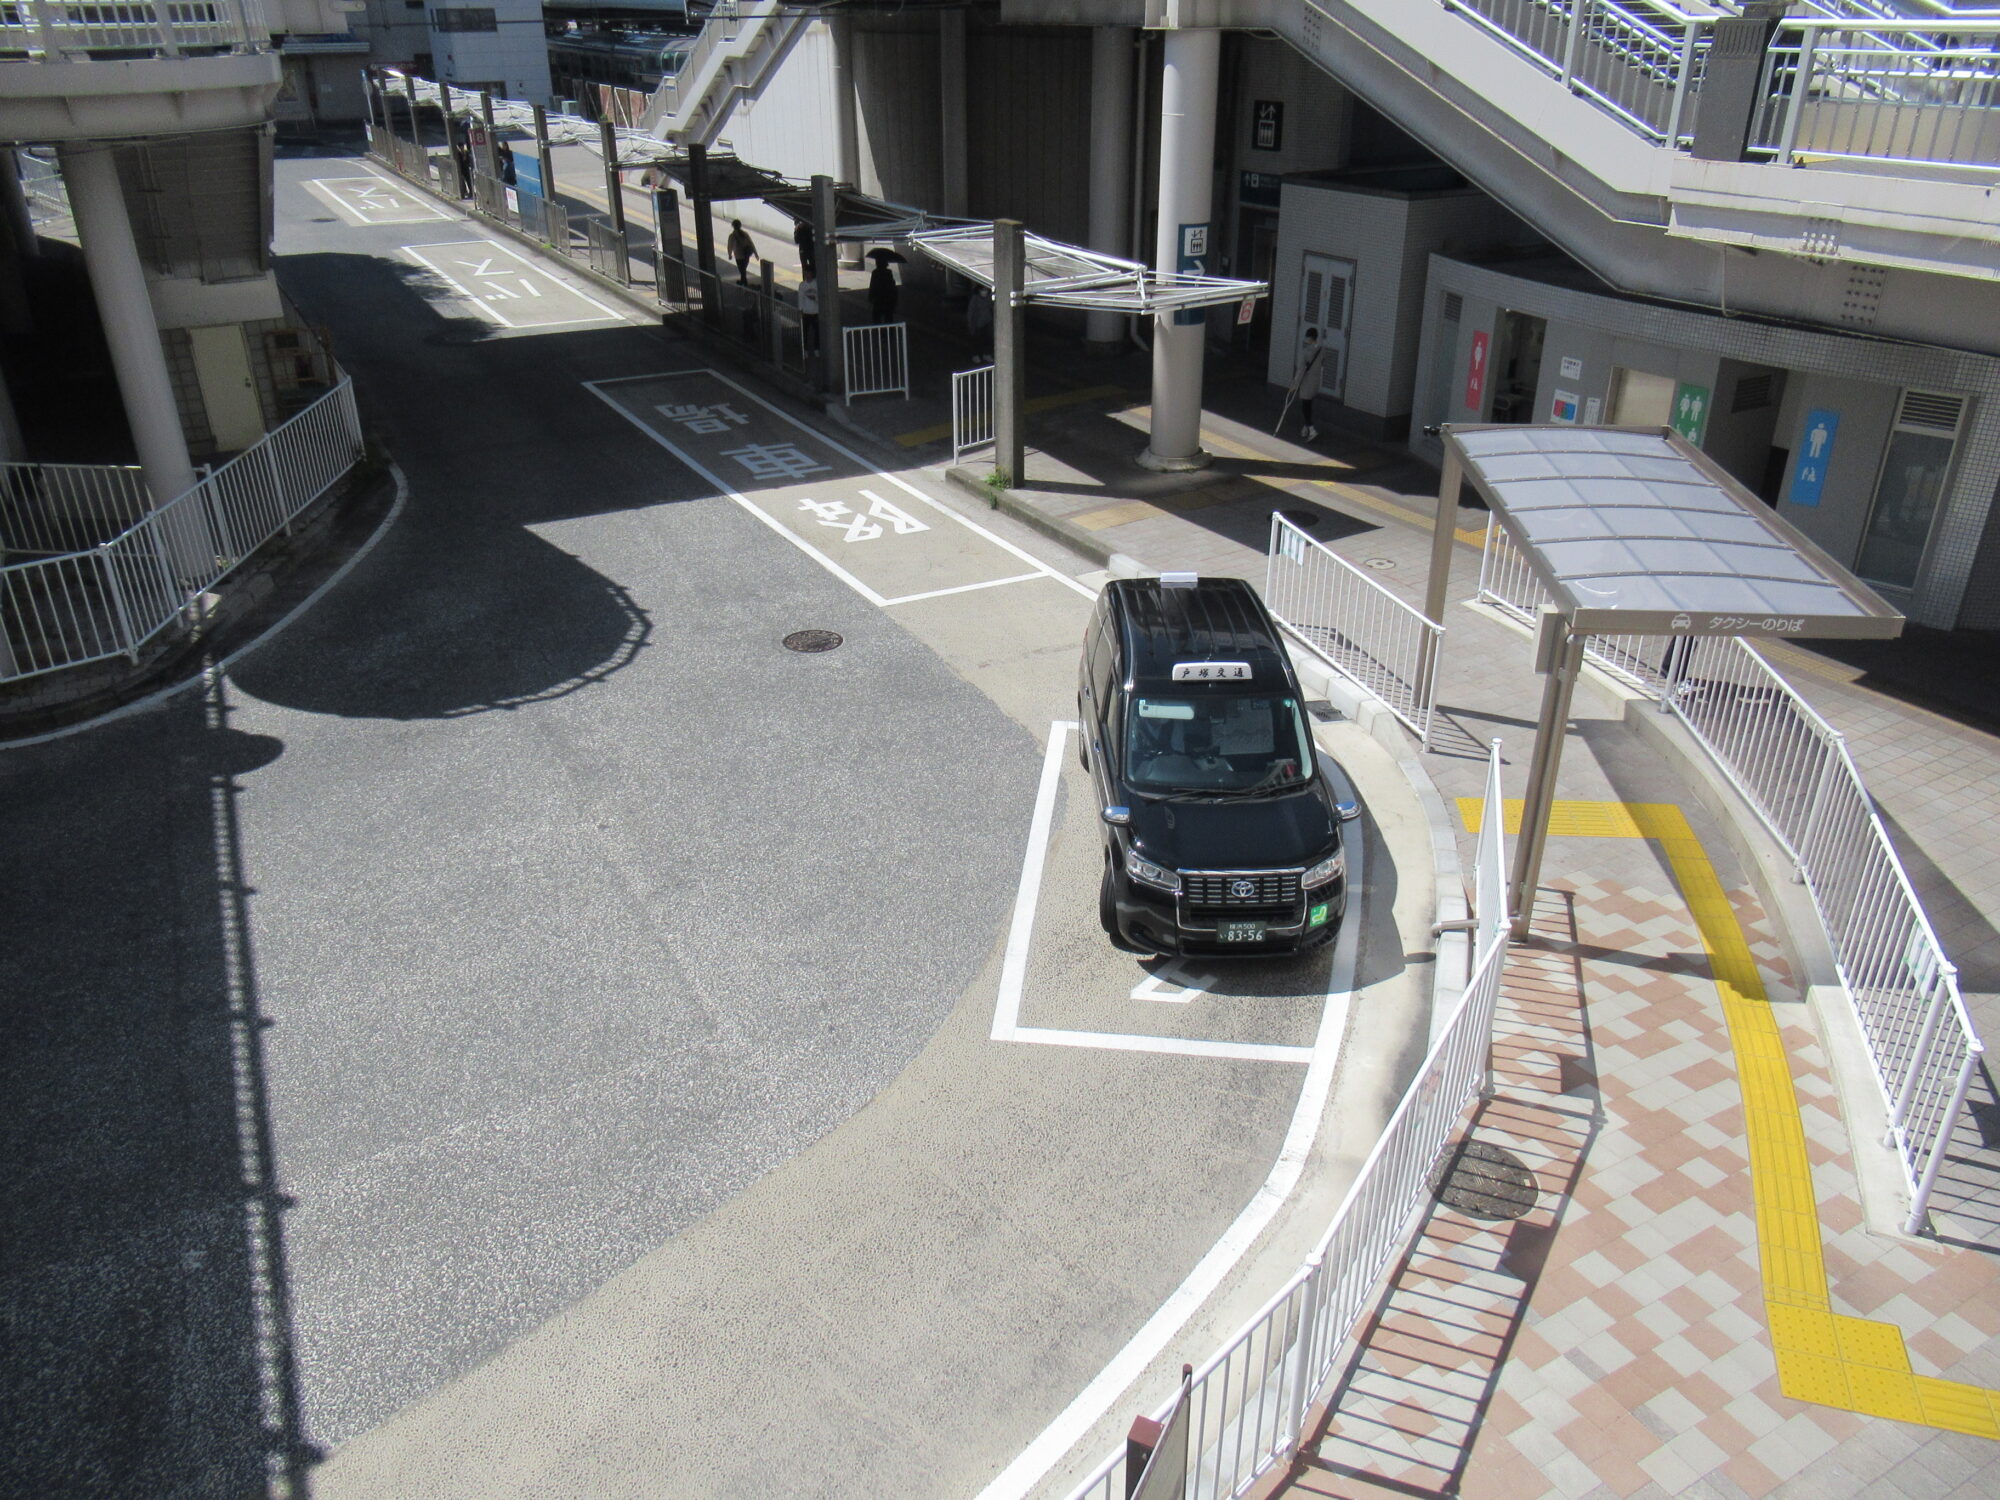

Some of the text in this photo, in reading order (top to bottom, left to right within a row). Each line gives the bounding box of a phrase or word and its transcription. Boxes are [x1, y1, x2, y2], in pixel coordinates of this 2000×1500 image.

[347, 186, 400, 210] バス
[454, 258, 542, 301] バス
[1240, 301, 1253, 321] 6
[1708, 615, 1805, 632] タクシーのりば
[1181, 667, 1244, 678] 戸塚交通
